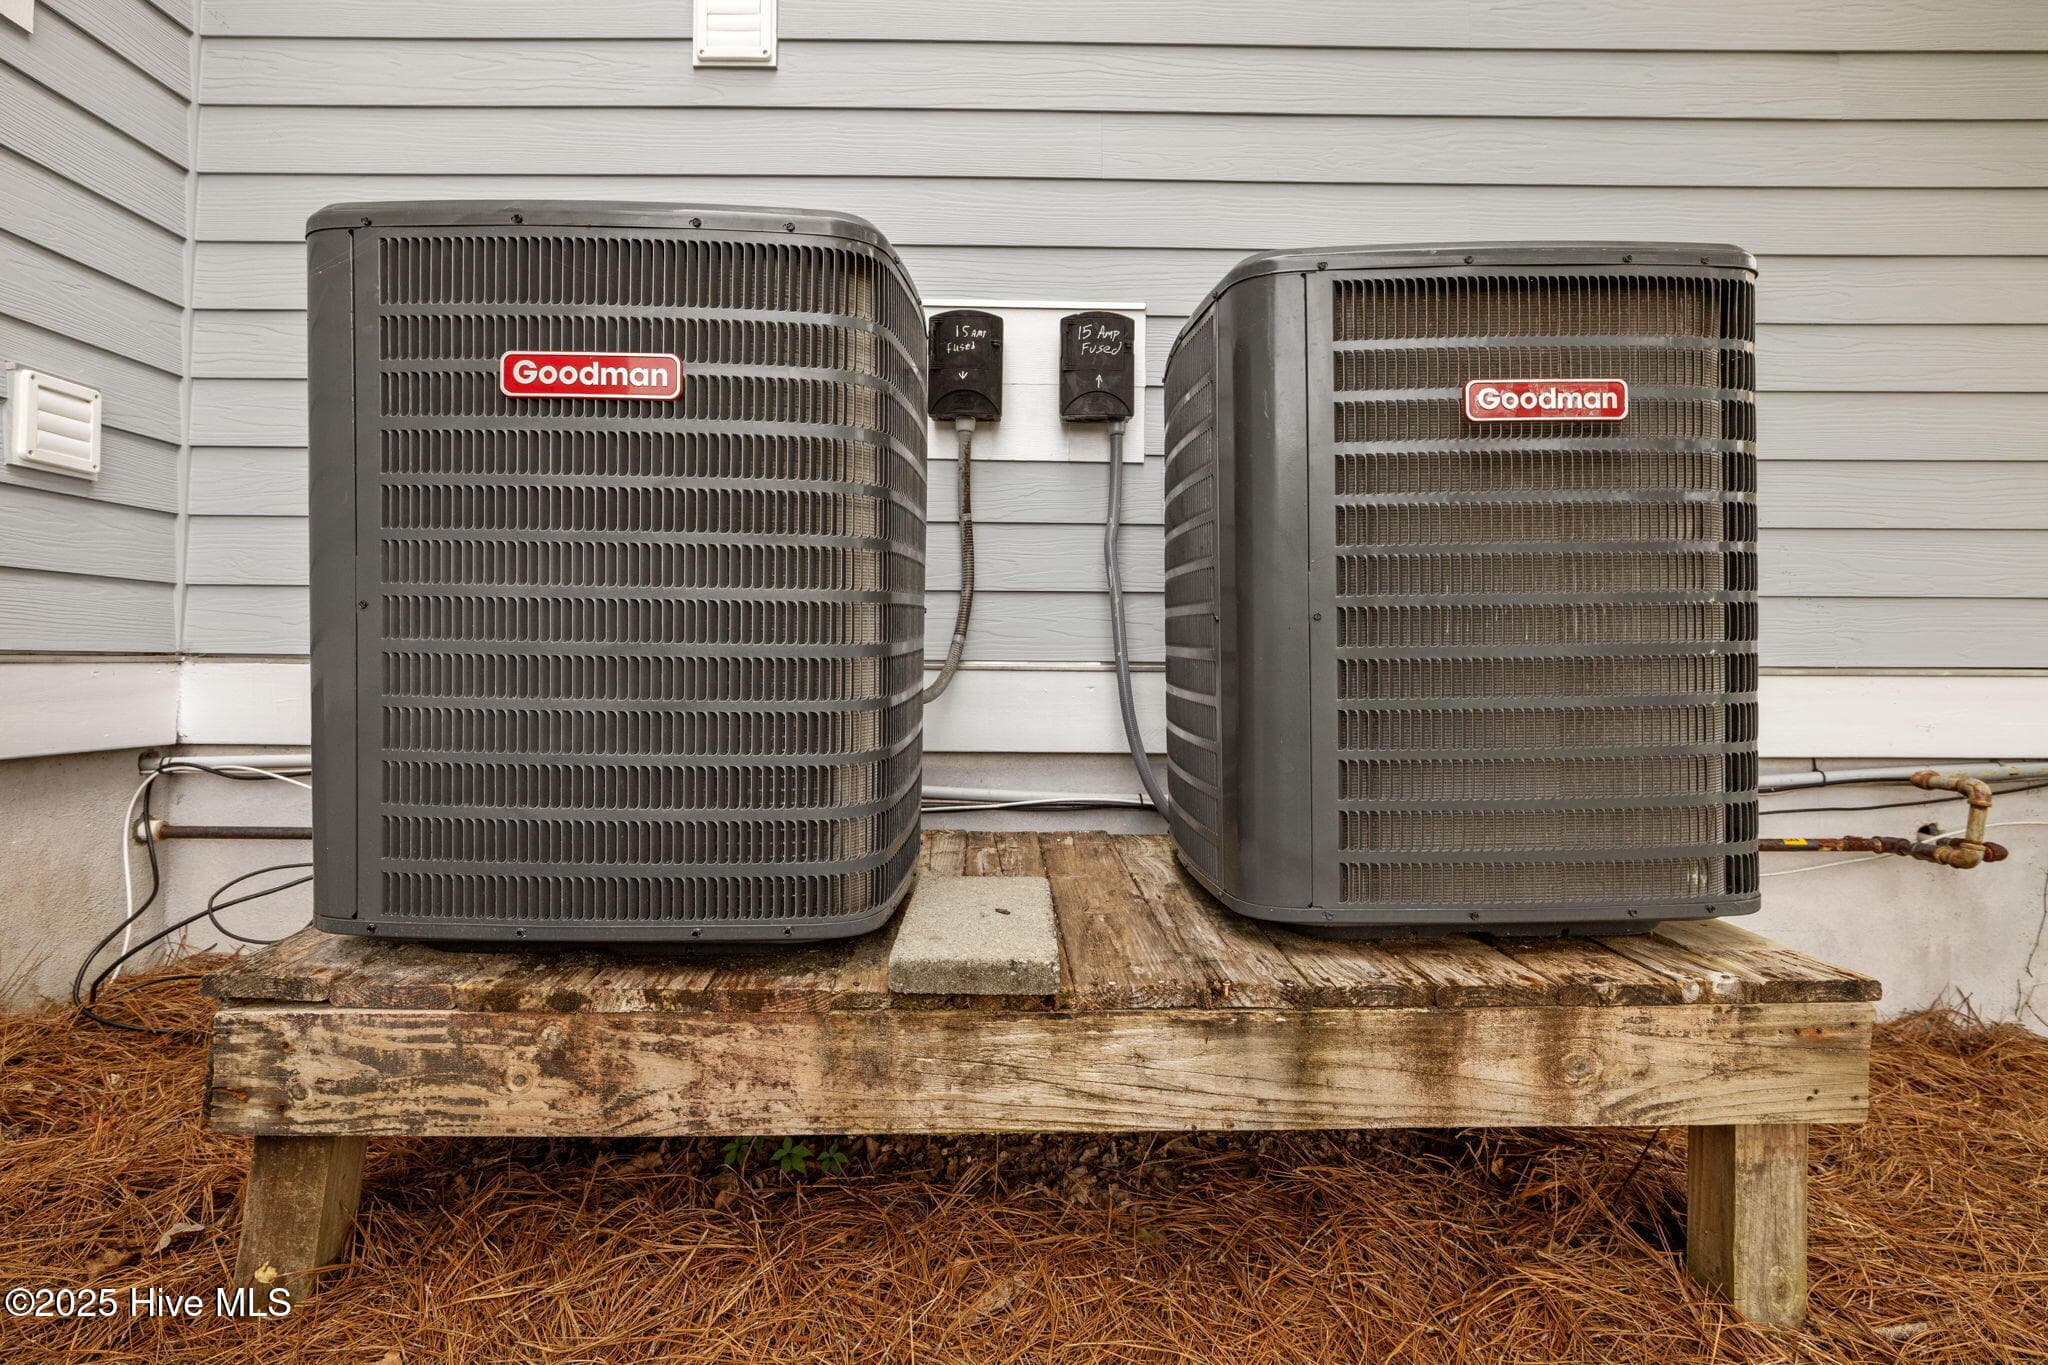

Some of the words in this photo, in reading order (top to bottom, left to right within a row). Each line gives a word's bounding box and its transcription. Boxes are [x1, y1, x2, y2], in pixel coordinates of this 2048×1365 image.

[955, 324, 971, 338] 15
[1077, 324, 1093, 340] 15
[1096, 324, 1121, 342] Amp
[1081, 341, 1123, 356] Fused
[512, 359, 668, 387] Goodman
[1476, 387, 1618, 410] Goodman
